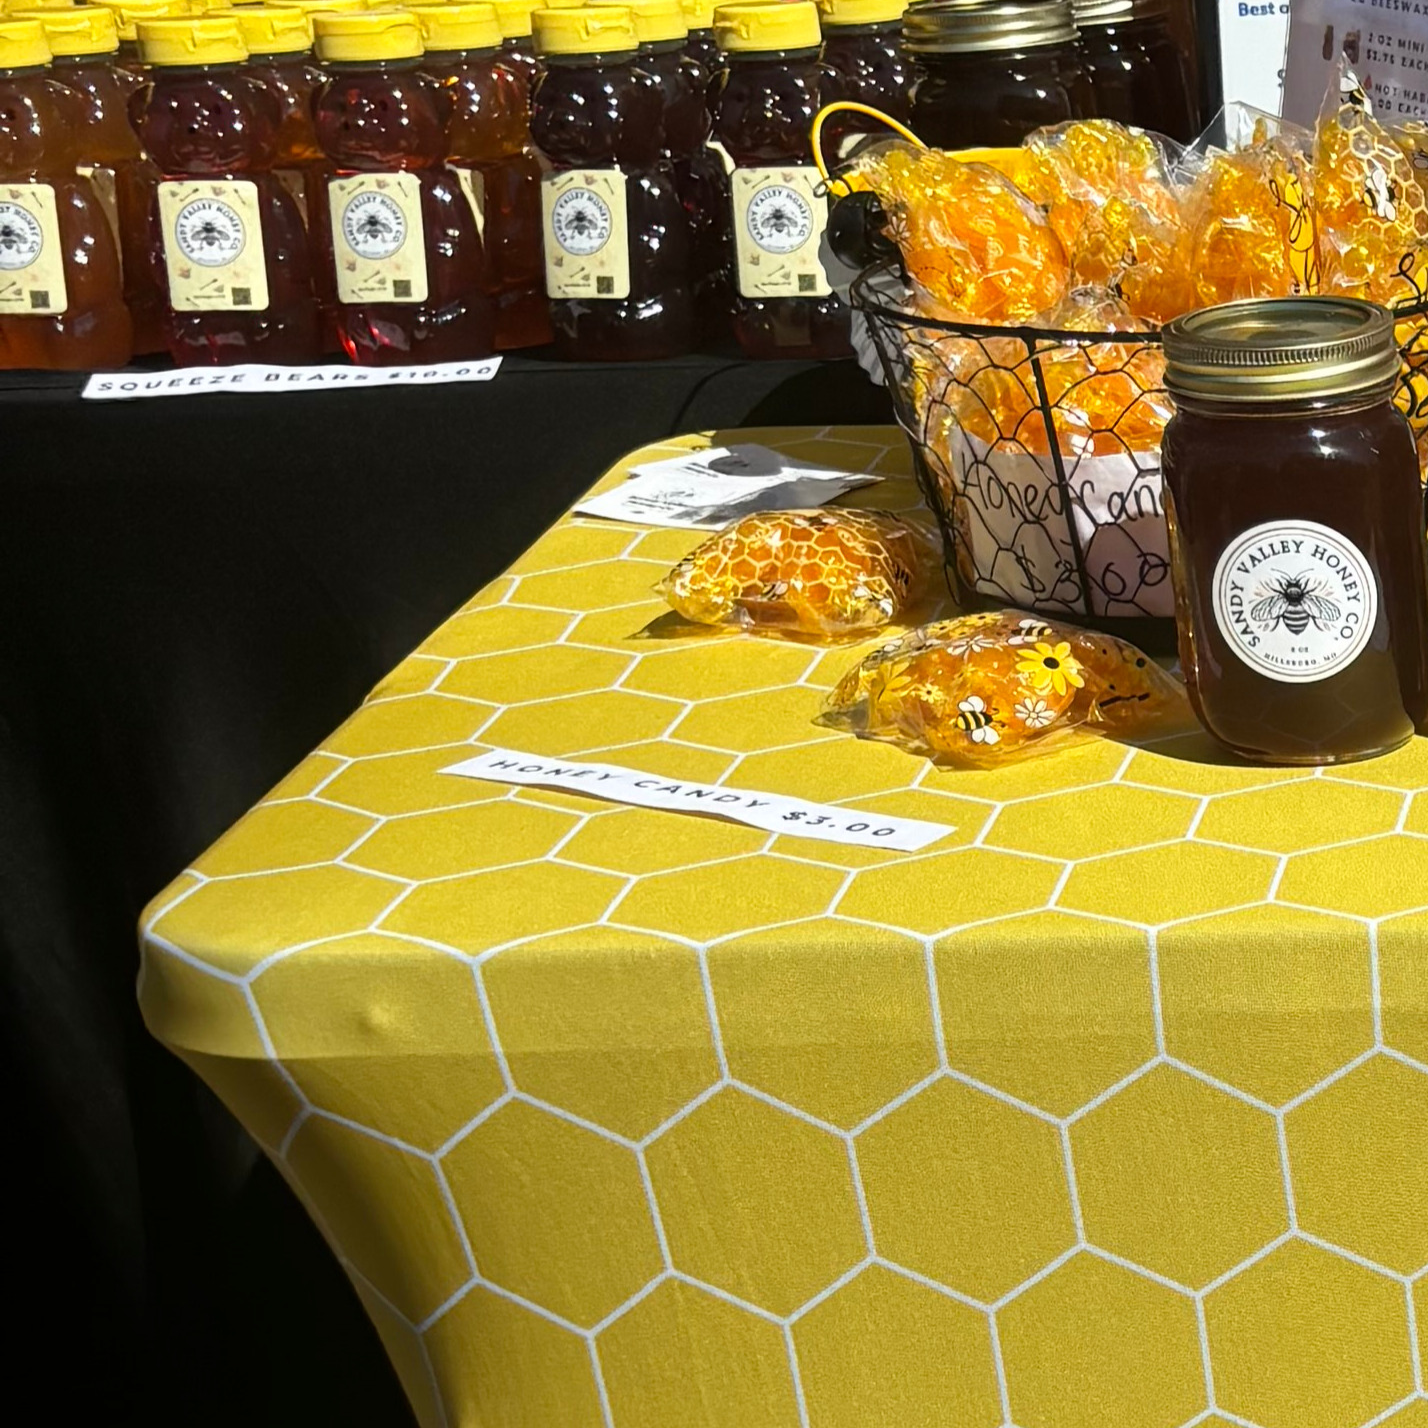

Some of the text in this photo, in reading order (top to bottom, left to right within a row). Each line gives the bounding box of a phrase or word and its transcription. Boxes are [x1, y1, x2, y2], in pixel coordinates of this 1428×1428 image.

[1238, 2, 1275, 17] Best
[1398, 38, 1425, 54] MINI
[97, 373, 246, 392] SQUEEZE
[264, 372, 369, 383] BEARS
[1237, 539, 1304, 574] VALLEY
[1311, 544, 1361, 603] HONEY
[1230, 580, 1260, 648] SANDY
[488, 758, 896, 838] HONEY CANDY $3.00
